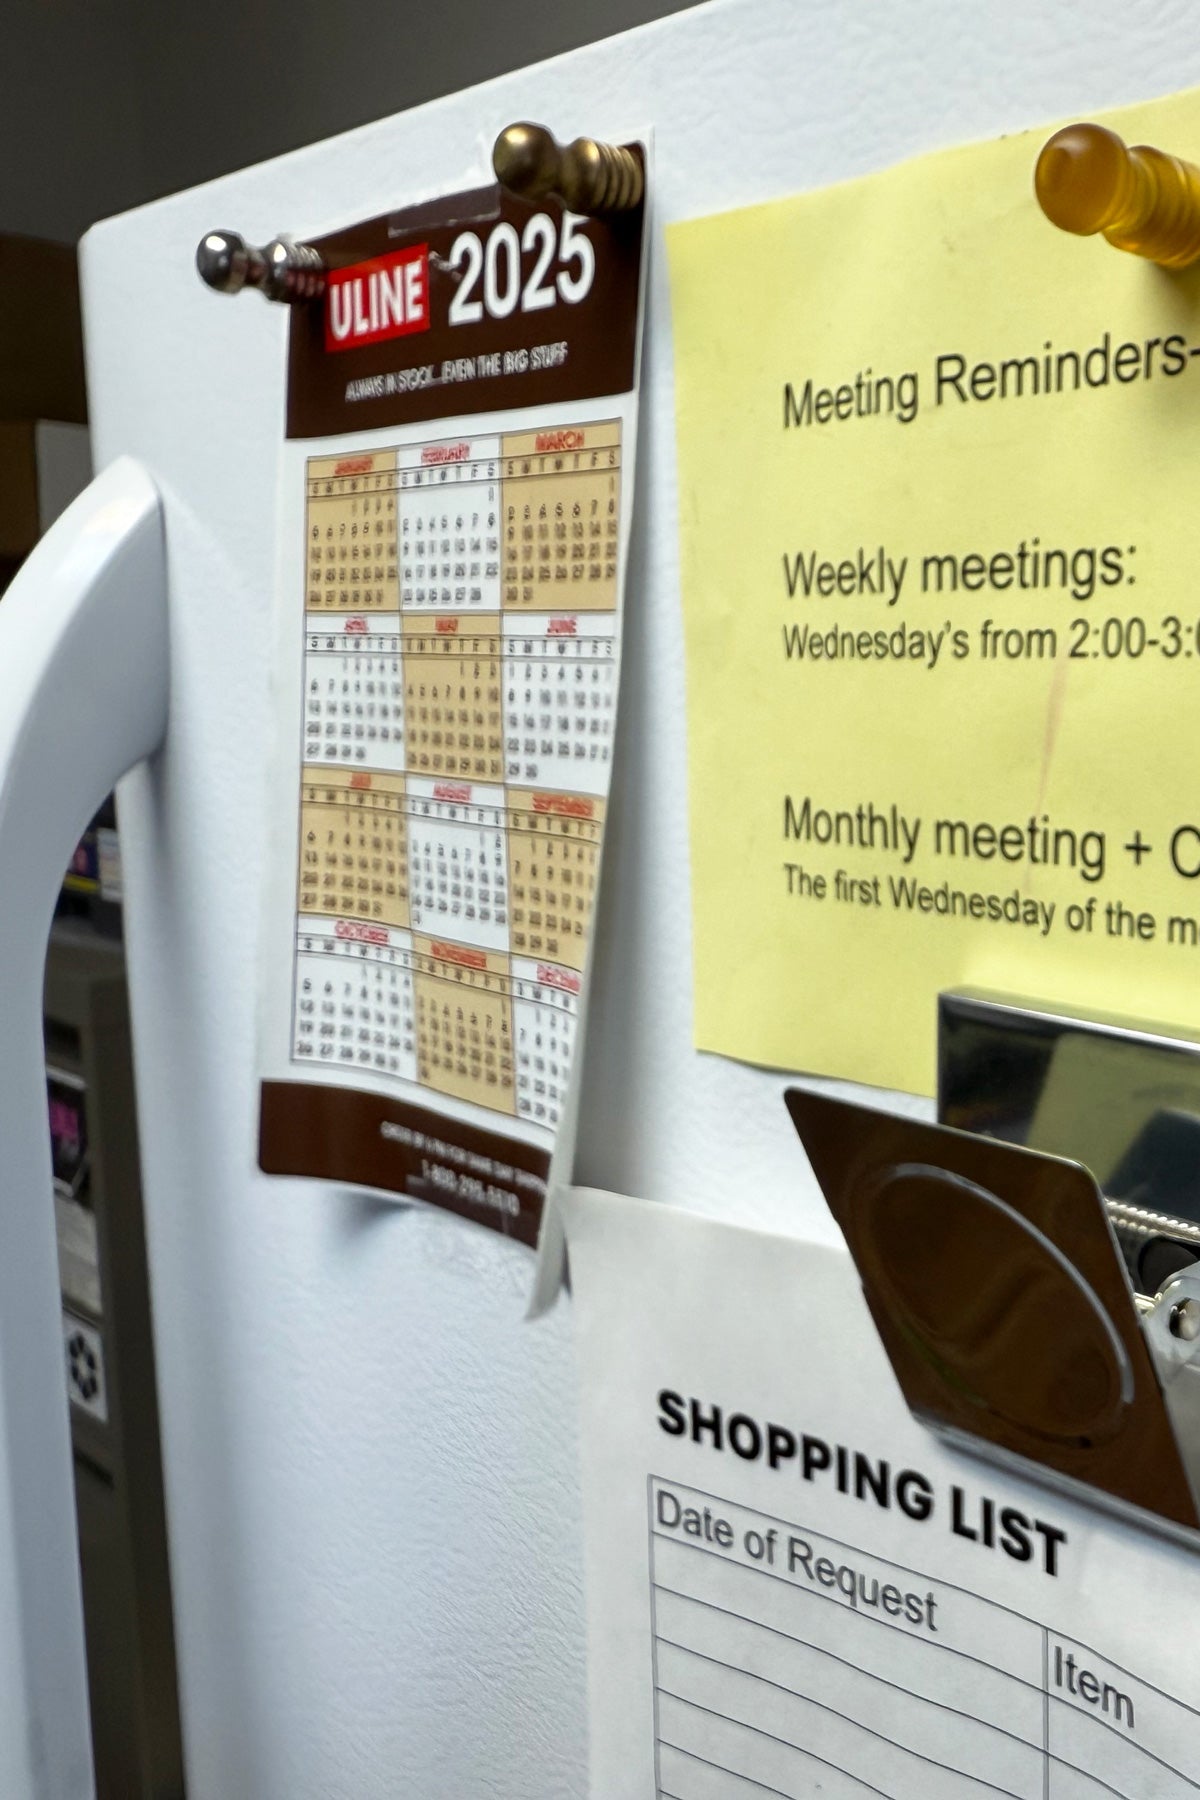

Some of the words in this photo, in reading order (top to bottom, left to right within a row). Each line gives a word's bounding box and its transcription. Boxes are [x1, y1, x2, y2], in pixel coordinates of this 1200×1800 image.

[330, 259, 425, 341] ULINE
[448, 211, 596, 326] 2025
[783, 367, 920, 430] Meeting
[782, 546, 909, 608] Weekly
[921, 536, 1137, 603] meetings:
[782, 619, 971, 671] Wednesday's
[979, 618, 1058, 660] from
[783, 795, 922, 866] Monthly
[934, 814, 1107, 884] meeting
[1123, 830, 1153, 867] +
[782, 862, 828, 901] The
[833, 868, 883, 908] first
[888, 875, 1057, 937] Wednesday
[1064, 896, 1098, 933] of
[1104, 900, 1157, 942] the
[656, 1387, 935, 1522] SHOPPING
[950, 1484, 1069, 1577] LIST
[657, 1488, 735, 1550] Date
[741, 1525, 779, 1566] of
[786, 1535, 940, 1632] Request
[1053, 1645, 1136, 1729] Item
